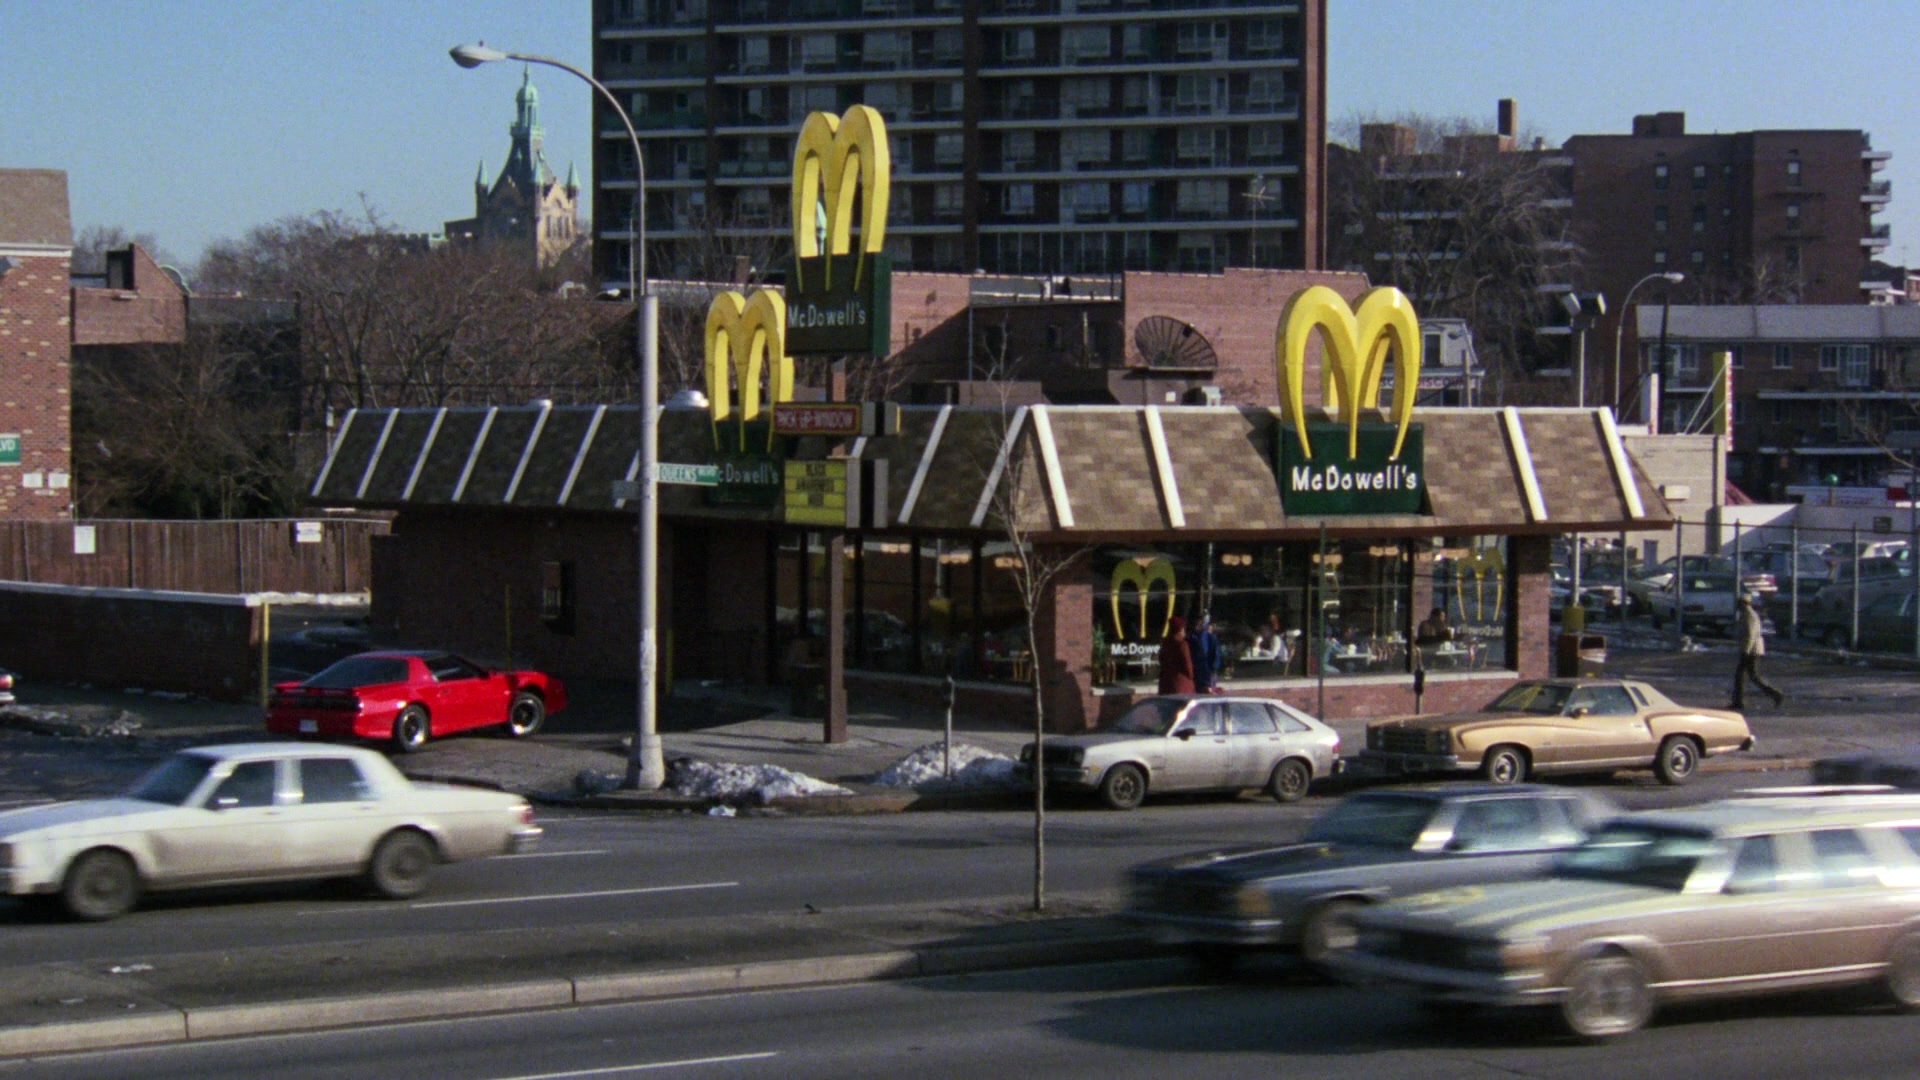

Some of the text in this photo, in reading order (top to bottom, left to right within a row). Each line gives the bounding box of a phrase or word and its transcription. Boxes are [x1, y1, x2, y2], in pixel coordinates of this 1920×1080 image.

[788, 300, 866, 328] McDowell's
[659, 464, 697, 482] QUEENS
[709, 462, 779, 484] cDowell's
[1292, 464, 1417, 491] McDowell's
[1111, 642, 1160, 655] McDowe
